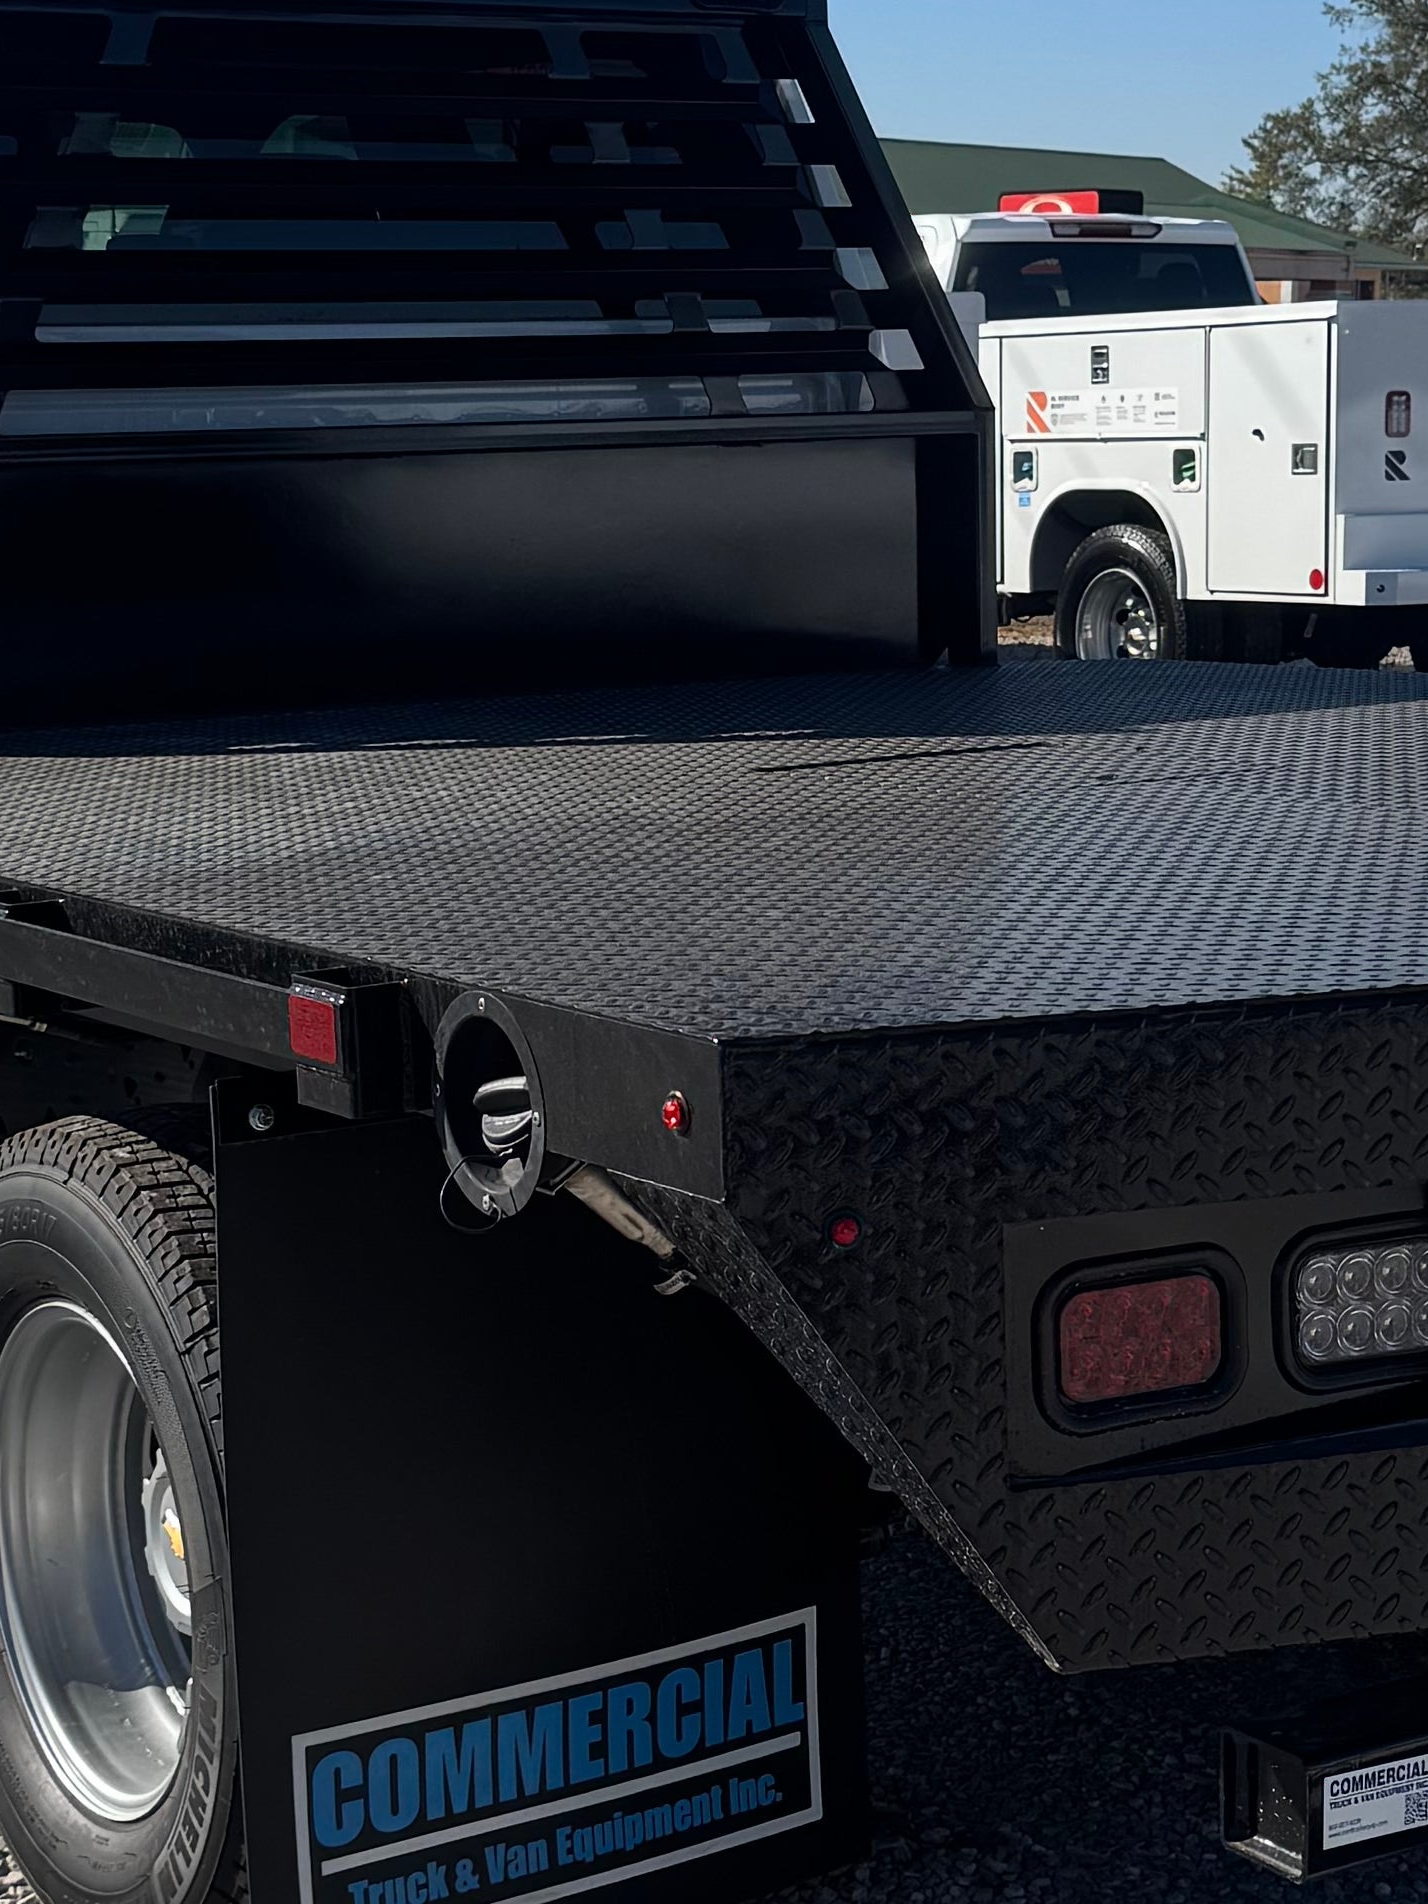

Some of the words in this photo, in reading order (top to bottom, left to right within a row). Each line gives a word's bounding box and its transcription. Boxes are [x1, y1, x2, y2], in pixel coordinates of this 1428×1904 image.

[312, 1639, 804, 1847] COMMERCIAL
[455, 1858, 480, 1893] &
[484, 1838, 549, 1885] Van
[556, 1785, 724, 1866] Equipment
[729, 1774, 783, 1816] Inc.
